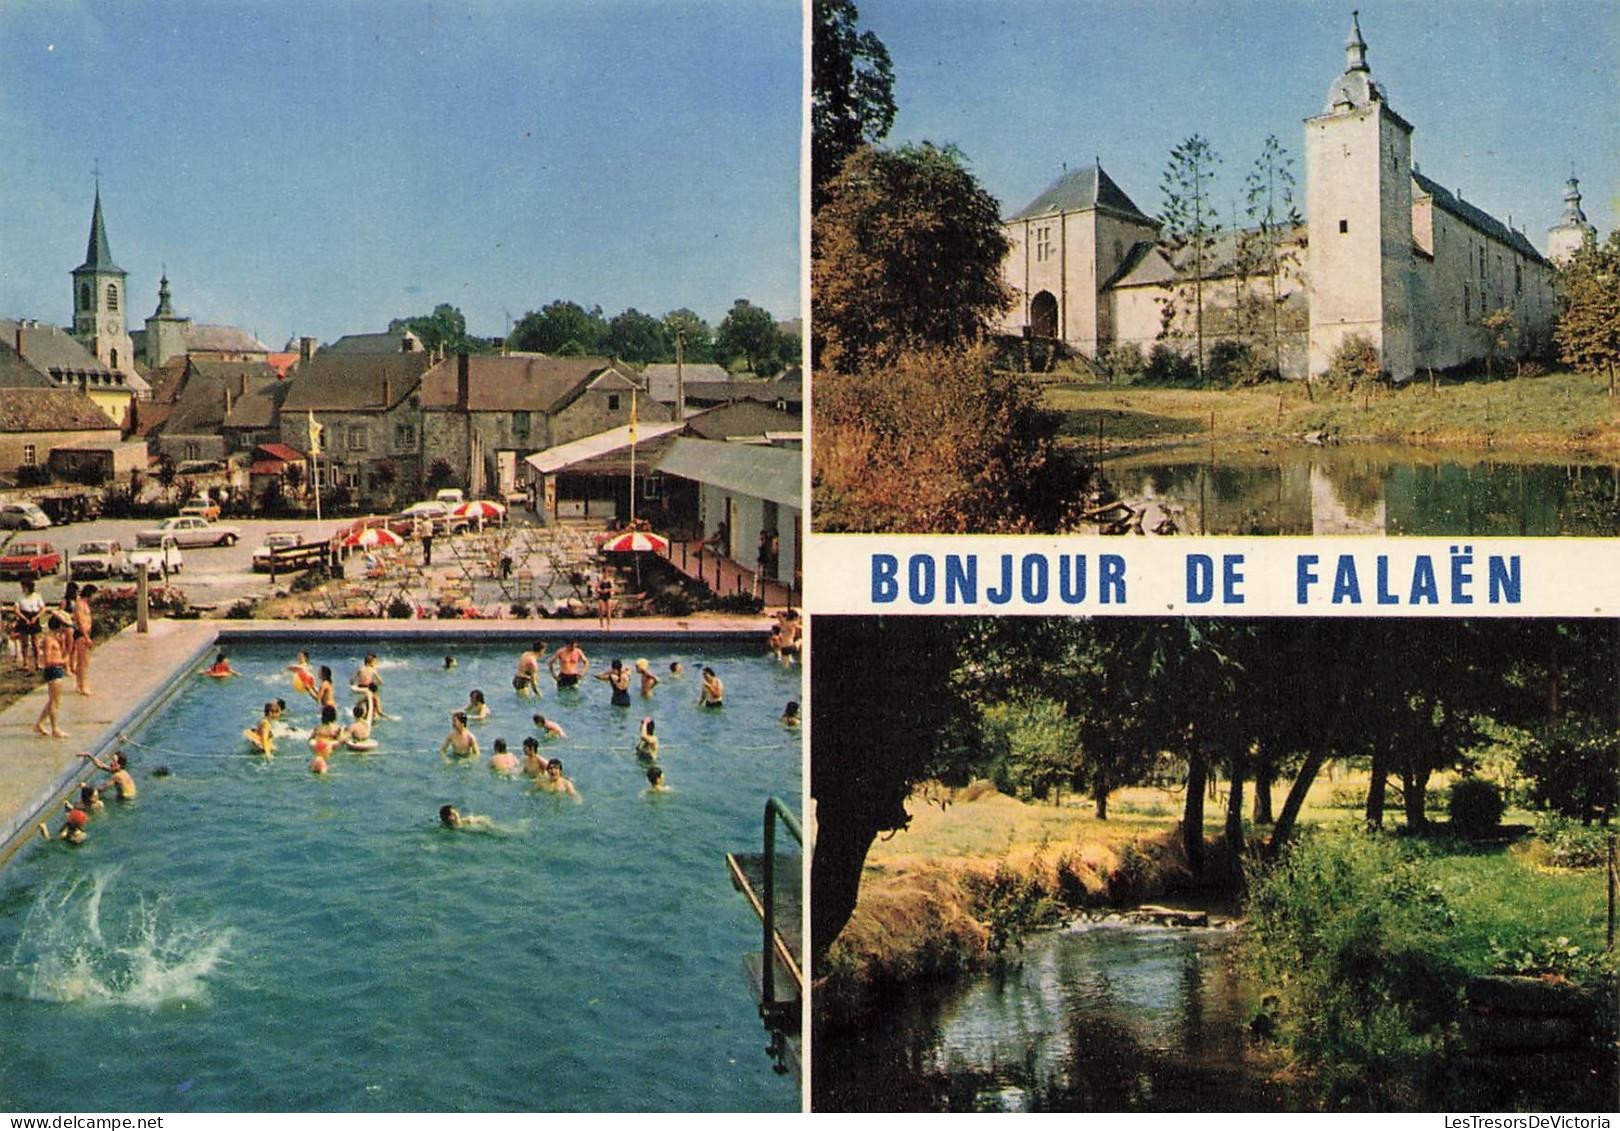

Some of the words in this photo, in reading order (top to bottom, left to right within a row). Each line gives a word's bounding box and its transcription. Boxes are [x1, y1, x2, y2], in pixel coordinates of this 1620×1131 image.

[871, 554, 1126, 605] BONJOUR
[1186, 554, 1245, 605] DE
[1296, 546, 1521, 605] FALAËN
